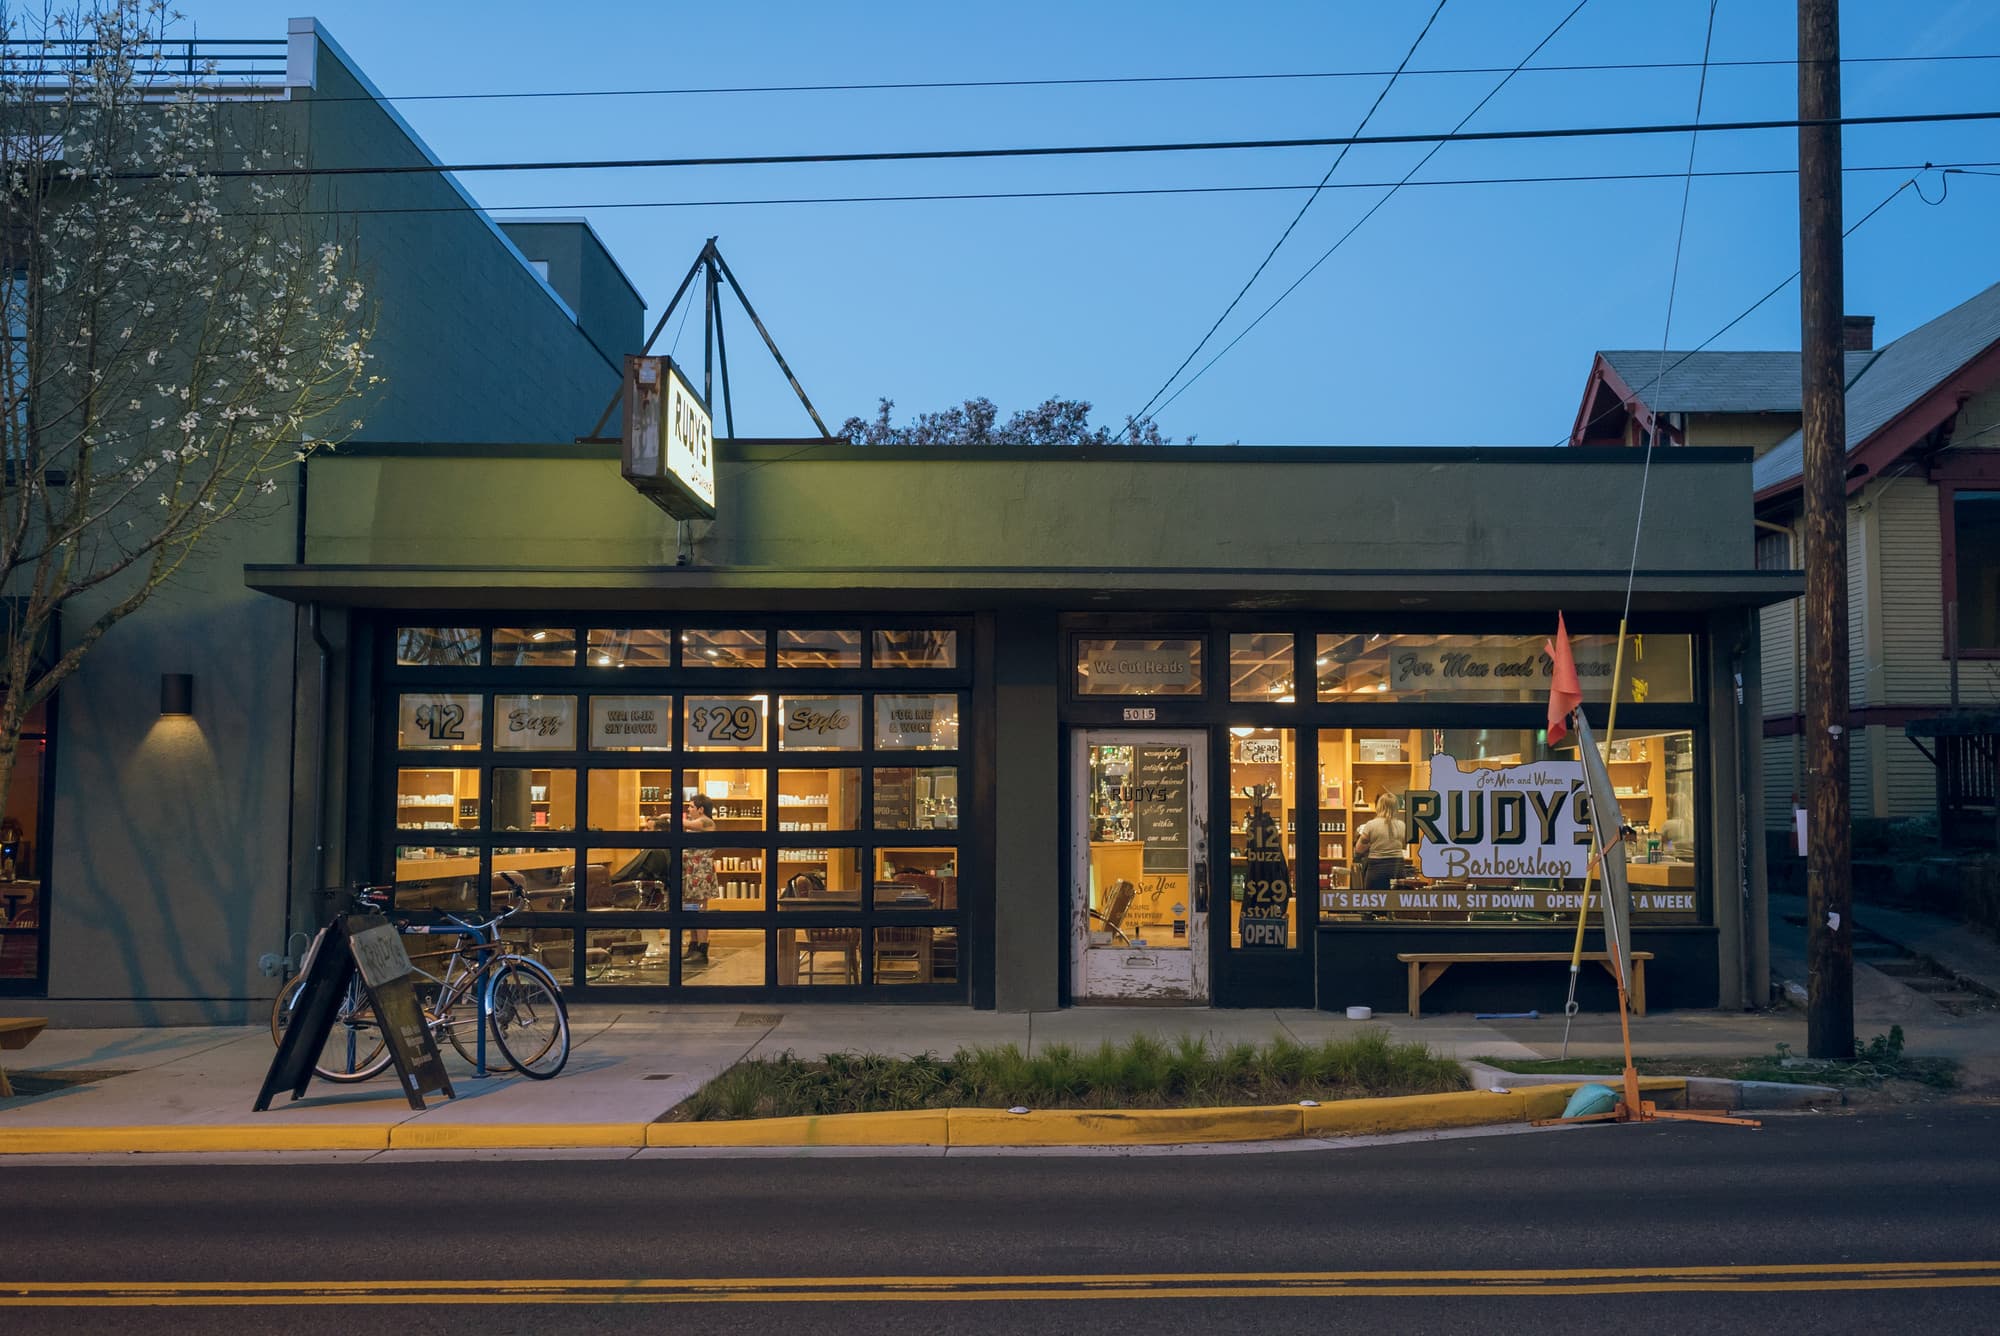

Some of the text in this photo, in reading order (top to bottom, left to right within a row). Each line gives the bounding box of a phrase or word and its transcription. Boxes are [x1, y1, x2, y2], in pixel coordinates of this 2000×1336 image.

[675, 390, 706, 467] RUDY'S
[1095, 660, 1184, 673] We Cut Heads
[1398, 652, 1612, 681] For Men and men
[415, 703, 464, 740] $12
[508, 709, 564, 736] Buzz
[693, 706, 757, 741] $29
[788, 707, 850, 734] Style
[891, 710, 938, 721] FOR ME
[1125, 709, 1154, 720] 3015
[624, 723, 658, 734] DOWN
[1246, 741, 1278, 753] Cheap
[1251, 753, 1276, 763] Cuts
[1476, 771, 1563, 788] For Men and Women
[1246, 825, 1280, 849] $12
[1247, 849, 1281, 861] buzz
[1440, 846, 1572, 880] Barbershop
[1136, 876, 1177, 902] See You
[1247, 880, 1288, 902] $29
[1322, 893, 1348, 907] IT'S
[1352, 893, 1387, 907] EASY
[1400, 893, 1438, 907] WALK
[1442, 894, 1461, 910] IN,
[1466, 894, 1488, 907] SIT
[1492, 894, 1535, 908] DOWN
[1547, 895, 1583, 908] OPEN
[1588, 895, 1597, 908] 7
[1639, 895, 1649, 908] A
[1653, 895, 1693, 909] WEEK
[1244, 923, 1285, 944] OPEN
